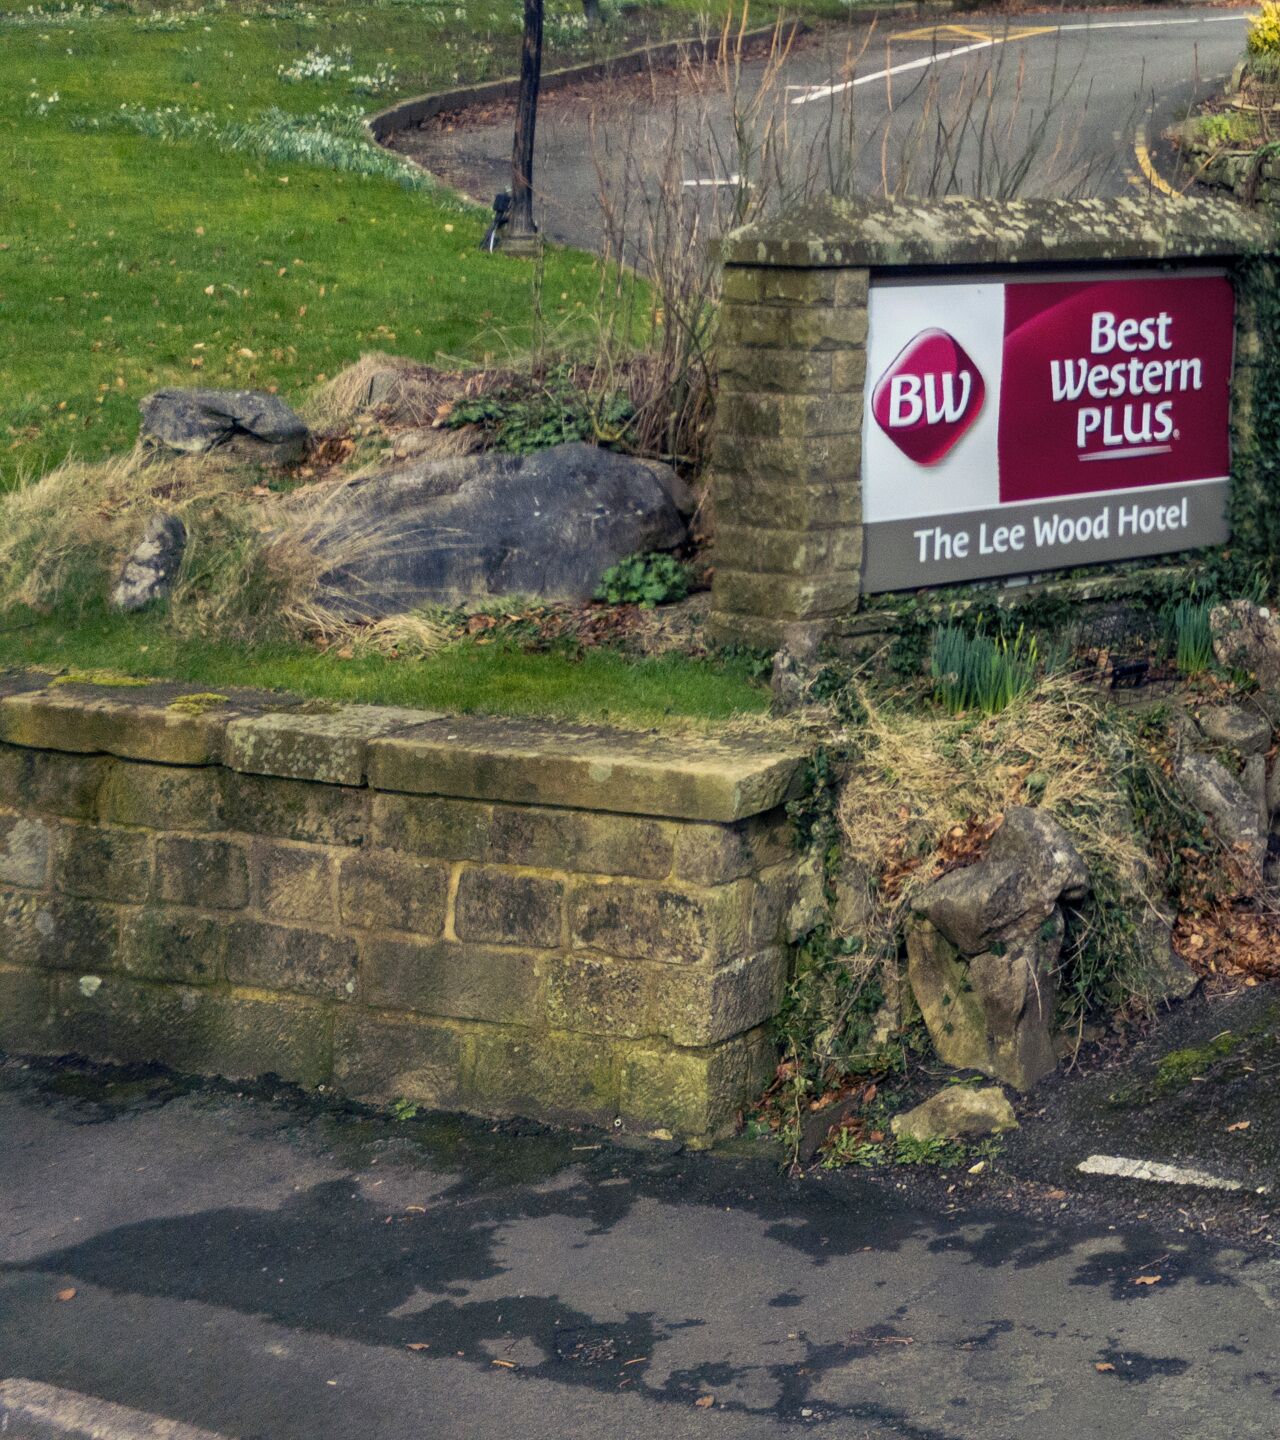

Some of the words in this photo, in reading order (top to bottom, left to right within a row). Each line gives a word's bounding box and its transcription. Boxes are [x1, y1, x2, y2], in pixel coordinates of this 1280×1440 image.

[1090, 310, 1173, 355] Best
[888, 371, 971, 428] BW
[1049, 357, 1202, 402] Western
[1076, 400, 1175, 448] PLUS
[914, 527, 969, 563] The
[979, 519, 1025, 555] Lee
[1033, 510, 1110, 545] Wood
[1118, 496, 1189, 536] Hotel
